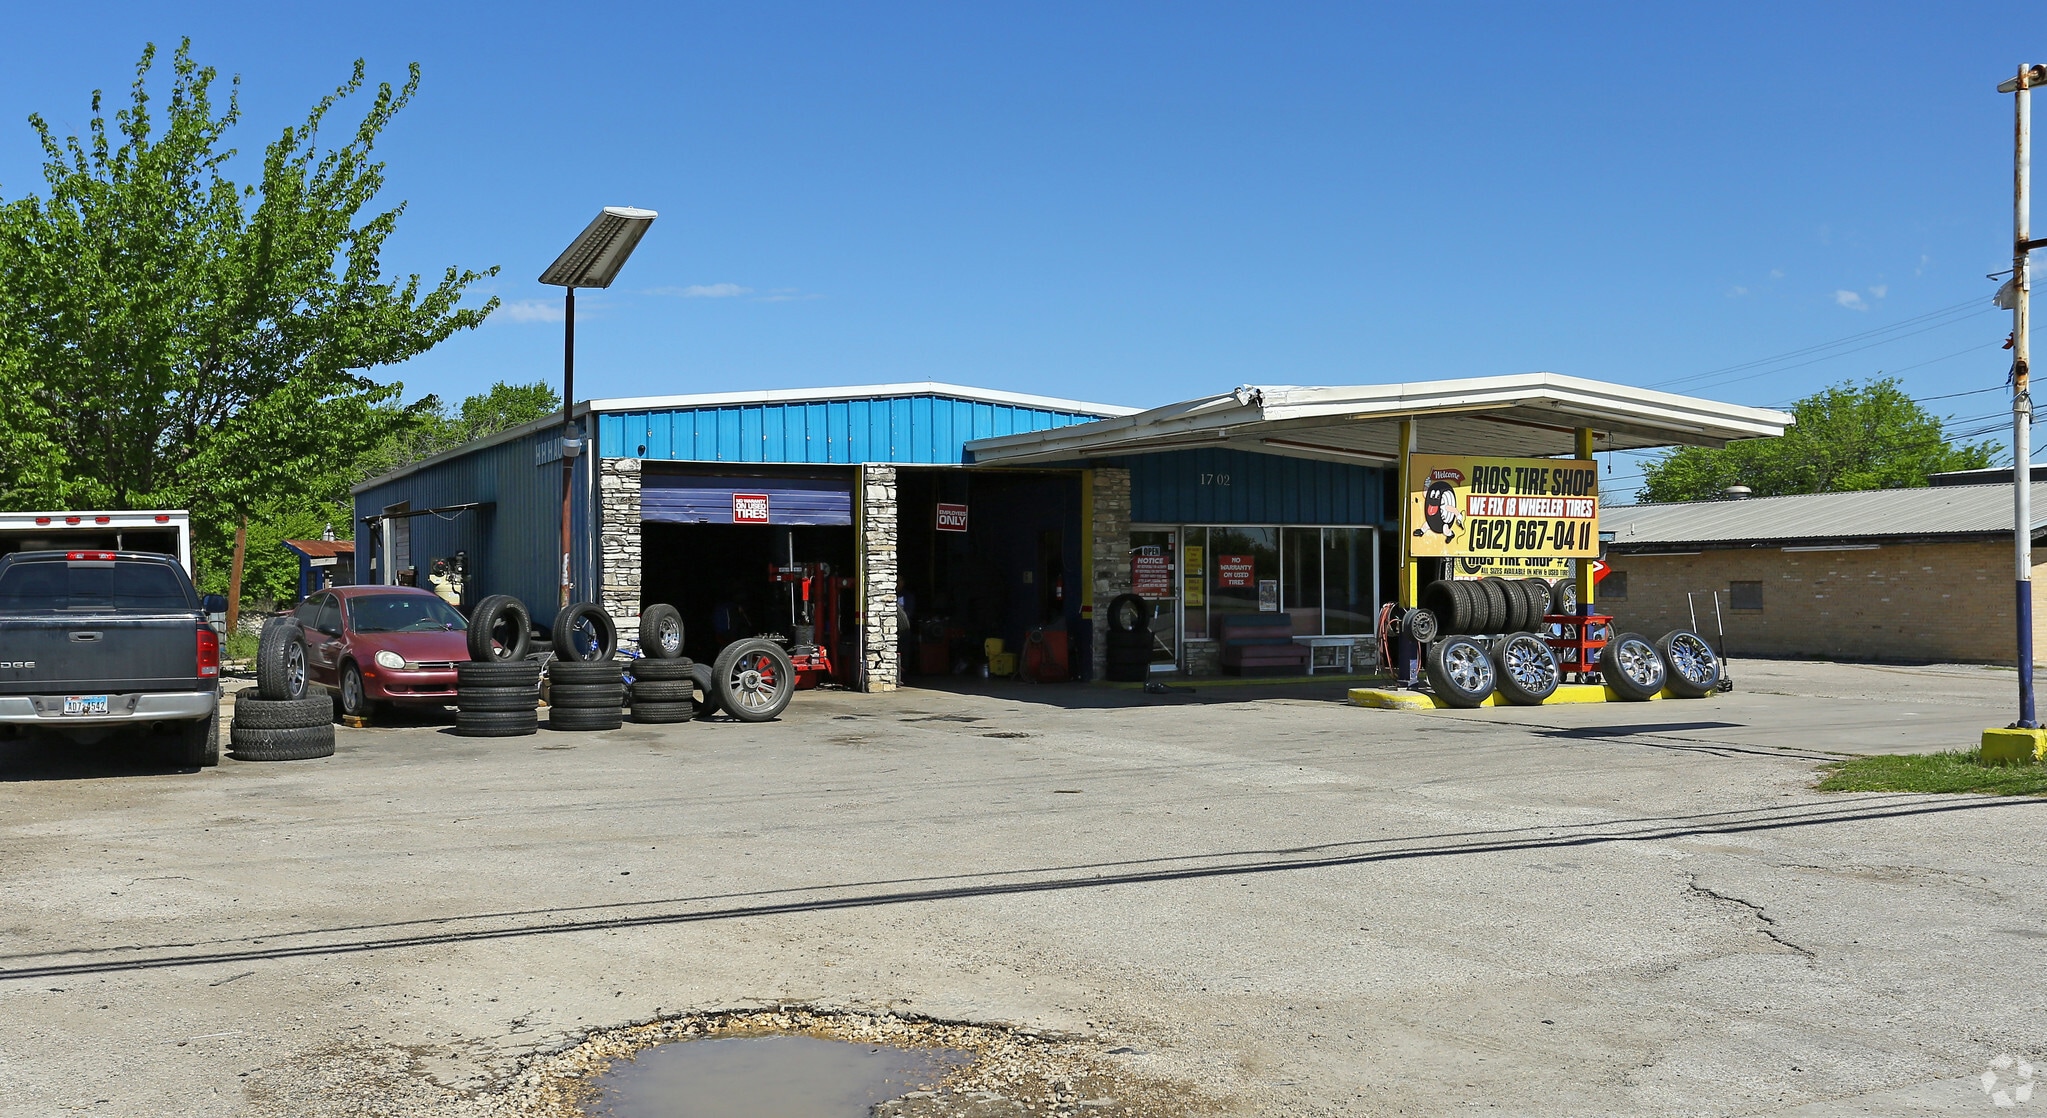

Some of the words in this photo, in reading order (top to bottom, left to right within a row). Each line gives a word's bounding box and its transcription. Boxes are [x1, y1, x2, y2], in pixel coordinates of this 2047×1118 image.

[1433, 470, 1460, 480] Welcome
[1471, 465, 1512, 494] RIOS
[1514, 467, 1549, 495] TIRE
[1551, 468, 1595, 496] SHOP
[736, 508, 767, 519] TIRES
[1469, 496, 1486, 515] WE
[1488, 497, 1504, 516] FIX
[1506, 497, 1516, 516] 18
[1518, 497, 1564, 517] WHEELER
[1565, 498, 1594, 518] TIRES
[939, 515, 966, 526] ONLY
[1468, 519, 1512, 552] (512)
